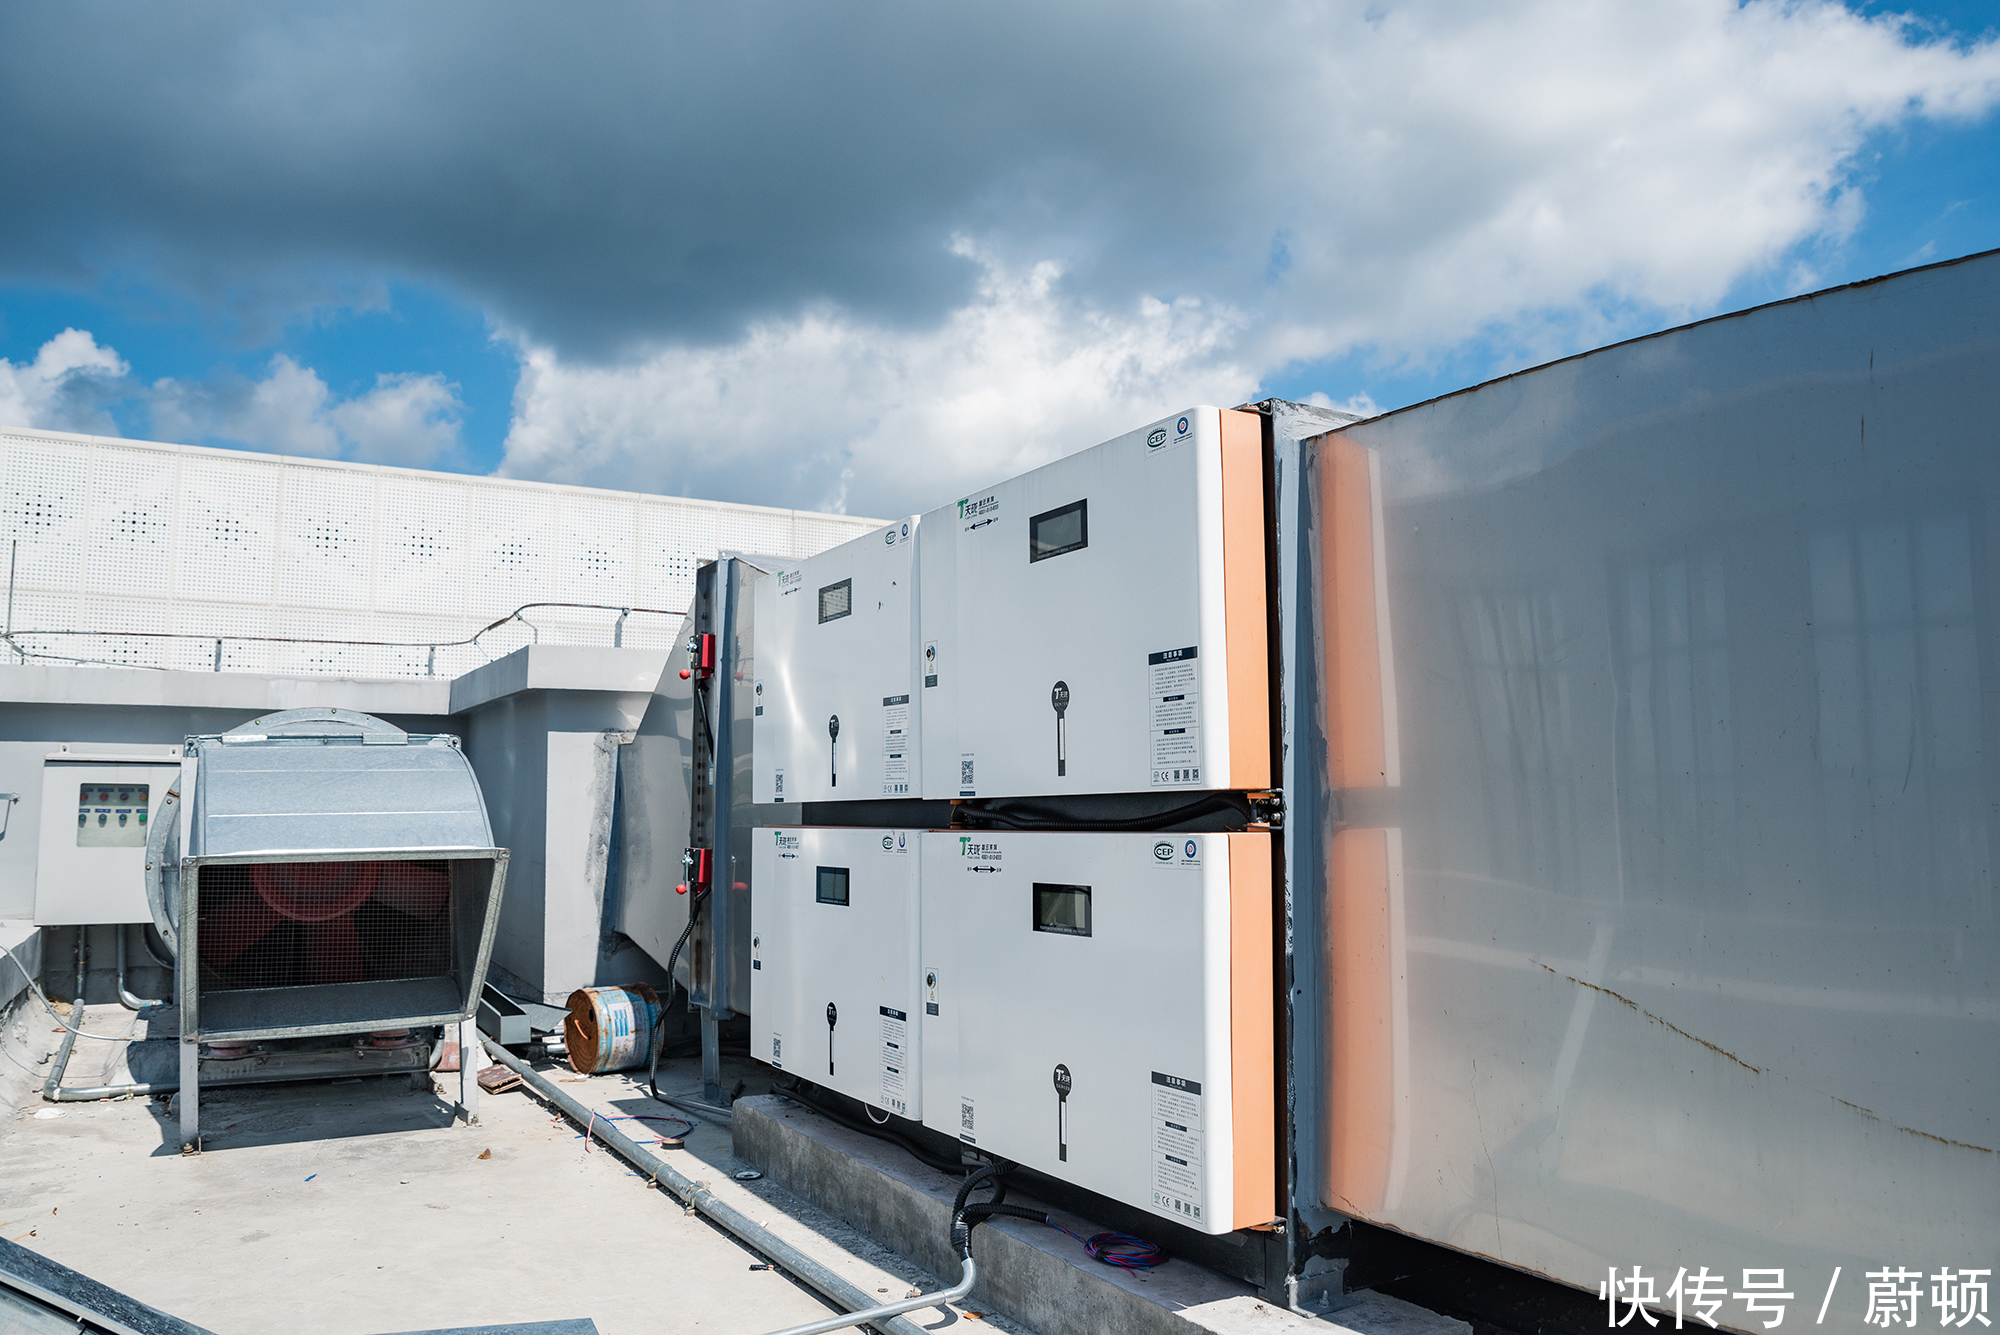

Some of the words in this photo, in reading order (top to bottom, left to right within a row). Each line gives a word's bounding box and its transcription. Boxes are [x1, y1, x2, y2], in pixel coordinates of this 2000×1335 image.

[1150, 433, 1166, 444] CEP
[1161, 771, 1169, 780] CE
[1162, 1196, 1170, 1206] CE
